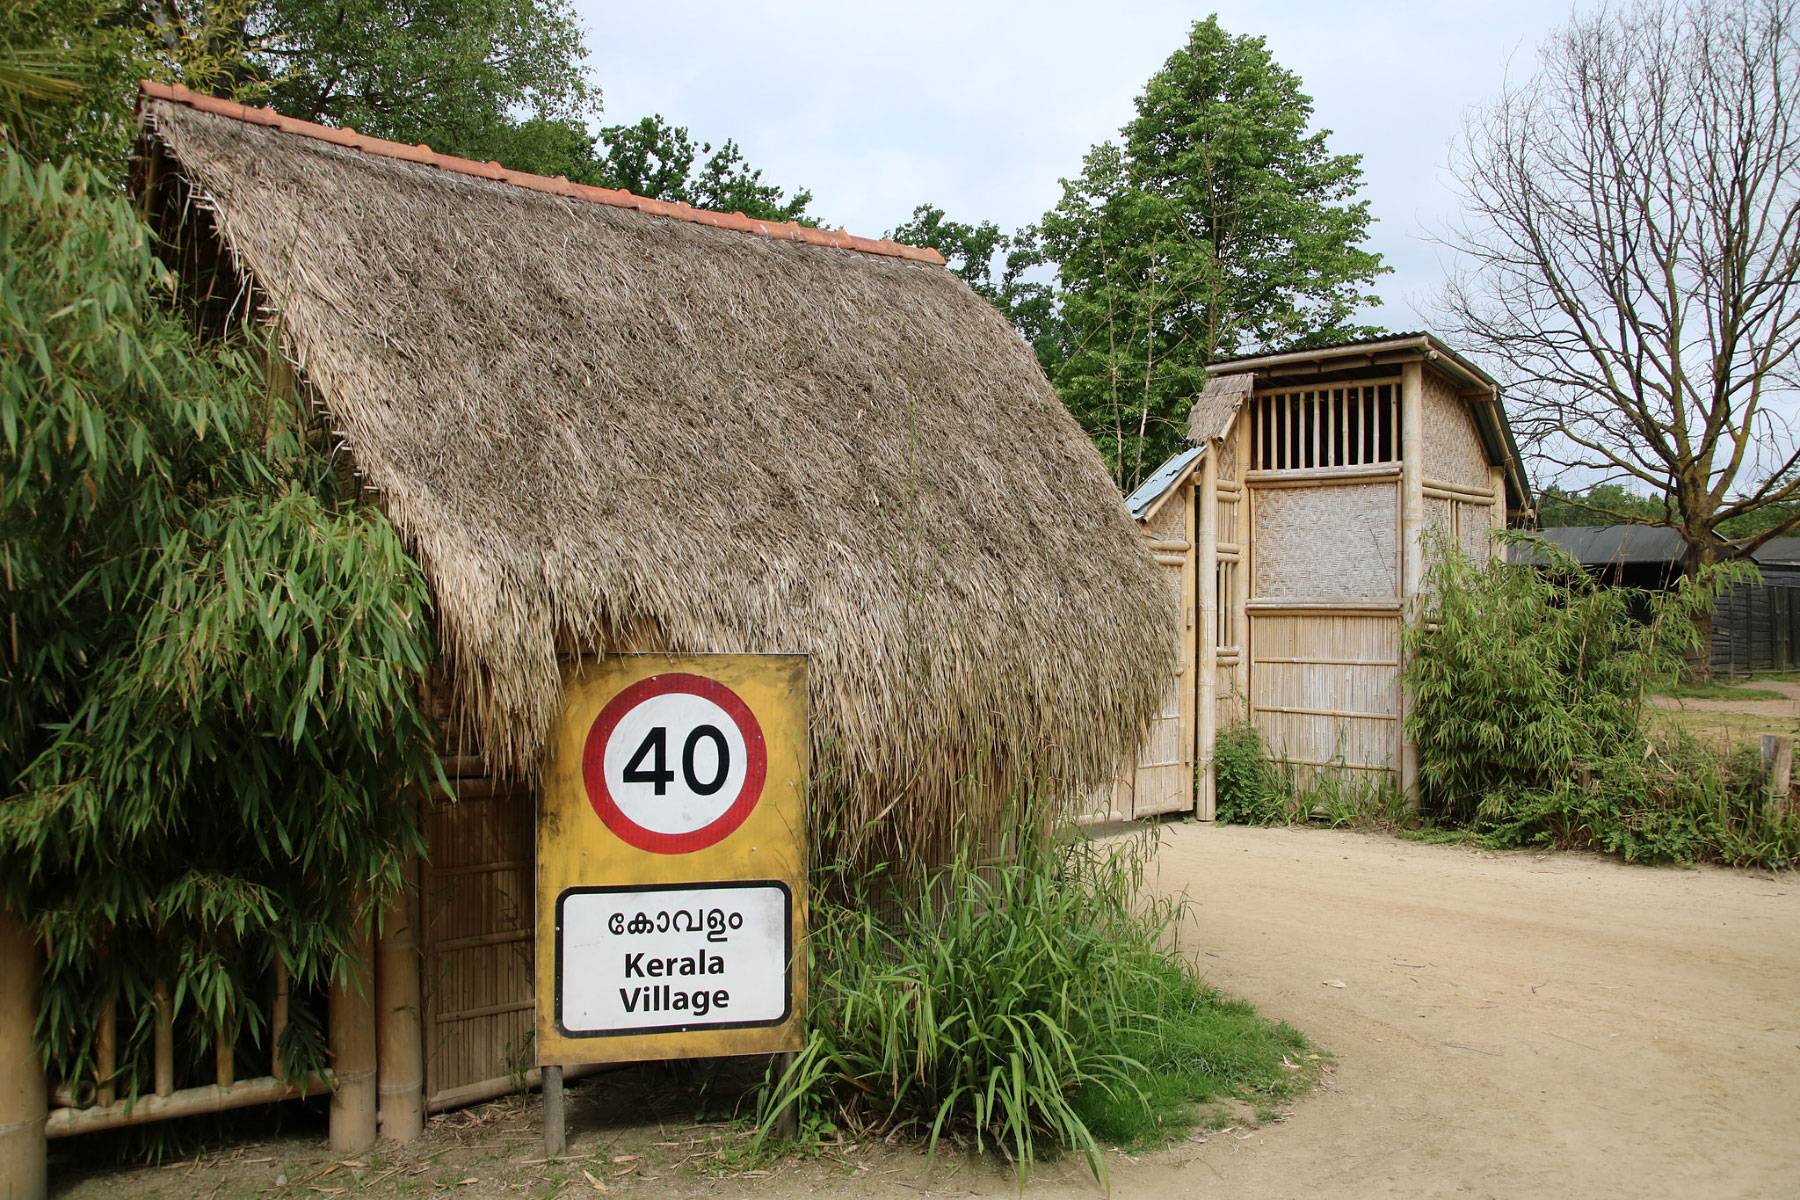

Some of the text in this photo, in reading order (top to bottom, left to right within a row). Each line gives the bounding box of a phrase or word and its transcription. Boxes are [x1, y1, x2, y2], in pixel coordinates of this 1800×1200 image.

[622, 724, 731, 796] 40
[608, 908, 743, 943] കോവളം
[625, 949, 725, 978] Kerala
[619, 984, 730, 1016] Village
